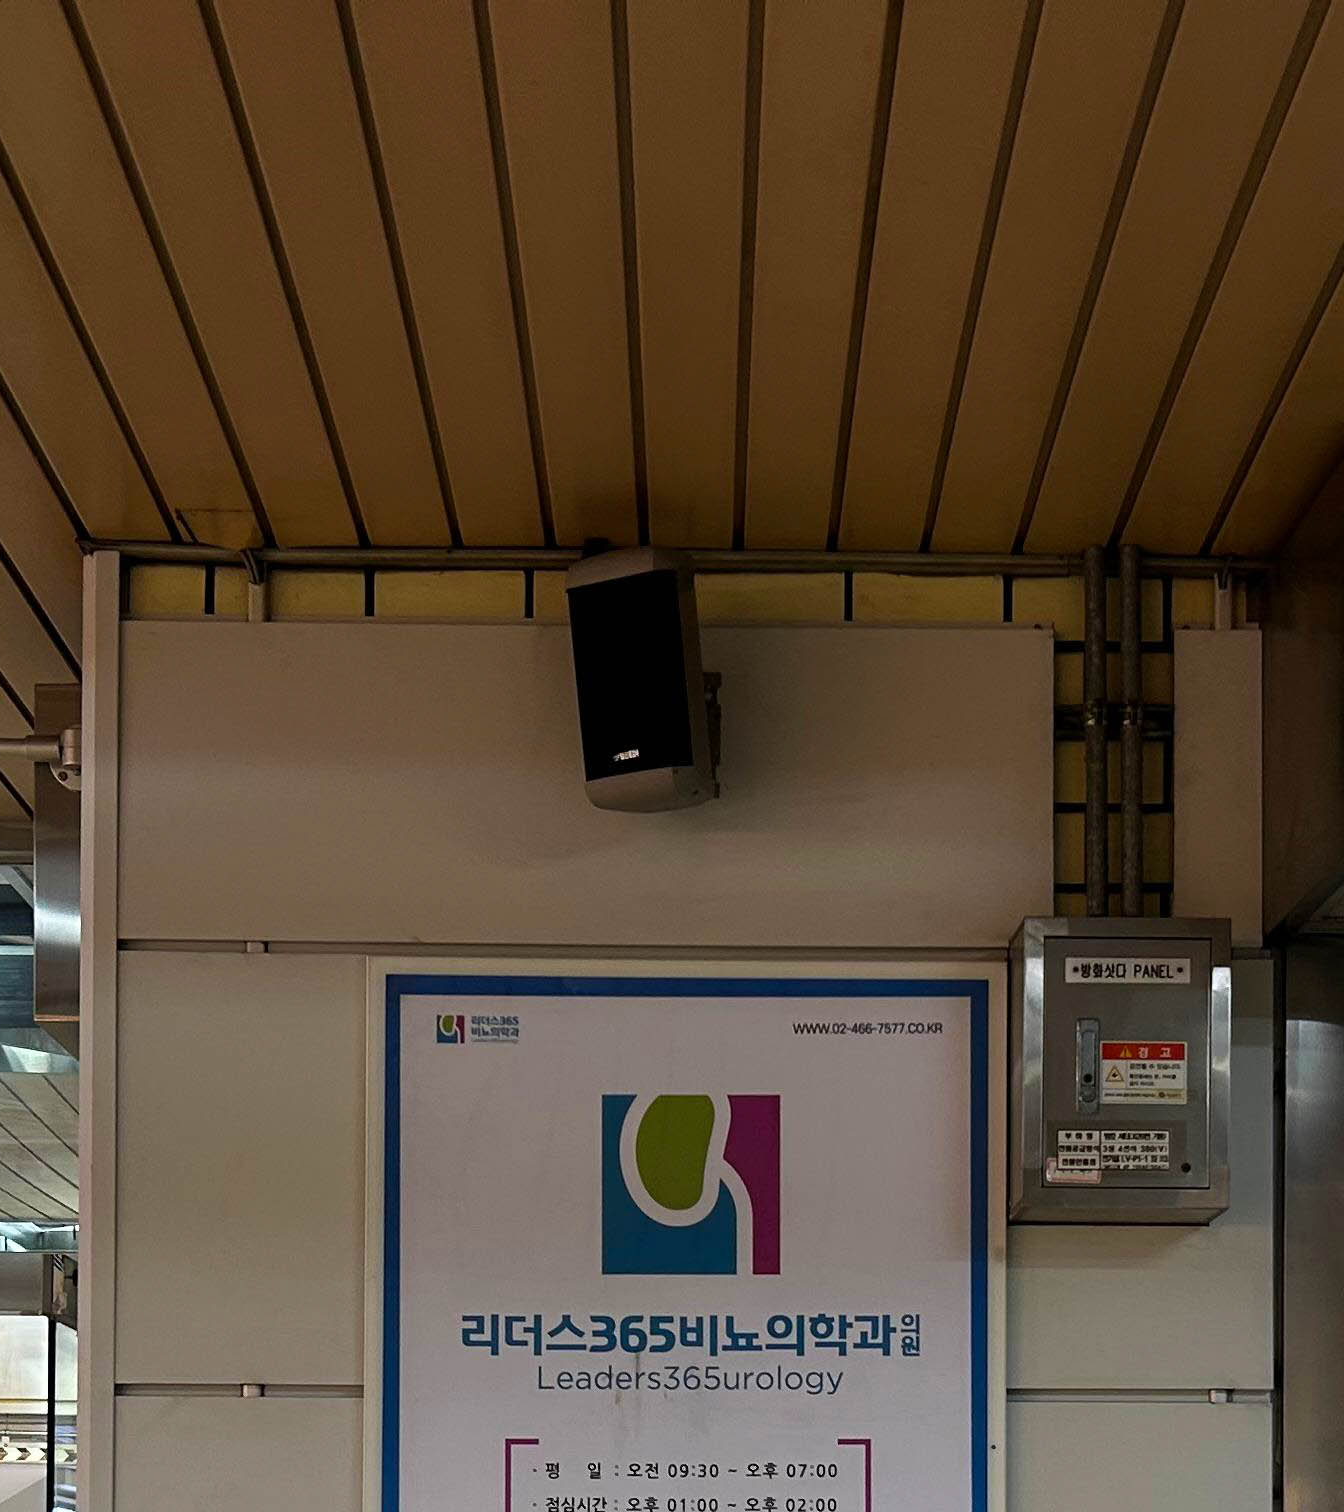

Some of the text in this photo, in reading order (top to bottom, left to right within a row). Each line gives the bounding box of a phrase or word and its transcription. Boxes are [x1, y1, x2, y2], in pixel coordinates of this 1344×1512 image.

[1133, 964, 1174, 978] PANEL
[461, 1314, 897, 1357] 리더스365비뇨의학과
[538, 1365, 844, 1395] Leaders365urology
[626, 1462, 659, 1480] 오전
[667, 1463, 719, 1479] 09:30
[745, 1462, 778, 1480] 오후
[786, 1463, 838, 1479] 07:00
[667, 1497, 719, 1512] 01:00
[785, 1498, 837, 1512] 02:00
